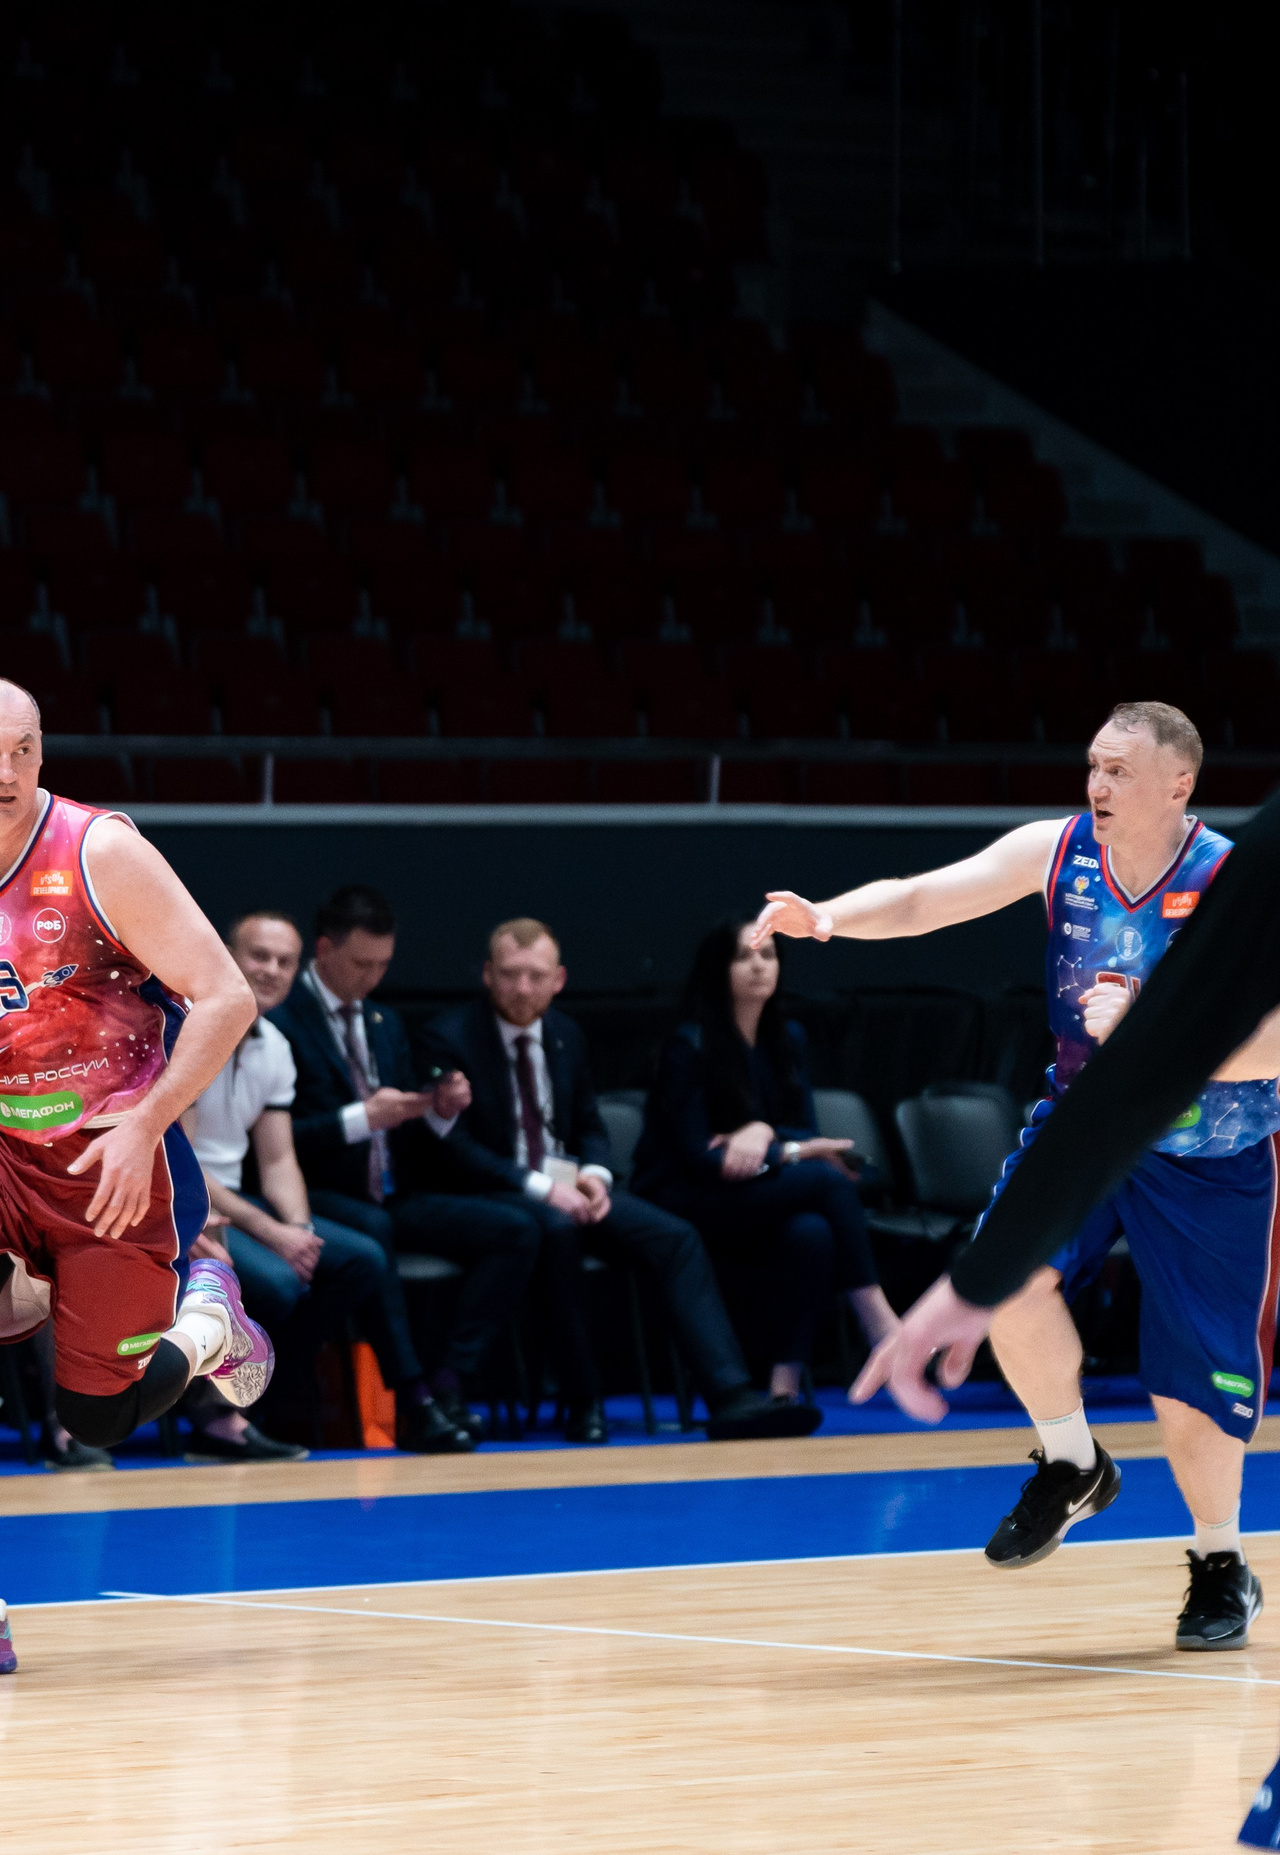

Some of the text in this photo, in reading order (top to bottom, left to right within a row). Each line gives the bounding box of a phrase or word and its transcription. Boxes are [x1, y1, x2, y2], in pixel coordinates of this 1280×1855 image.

[36, 920, 62, 931] РФБ
[33, 1057, 110, 1083] РОССИИ
[10, 1100, 75, 1119] МЕГАФОН
